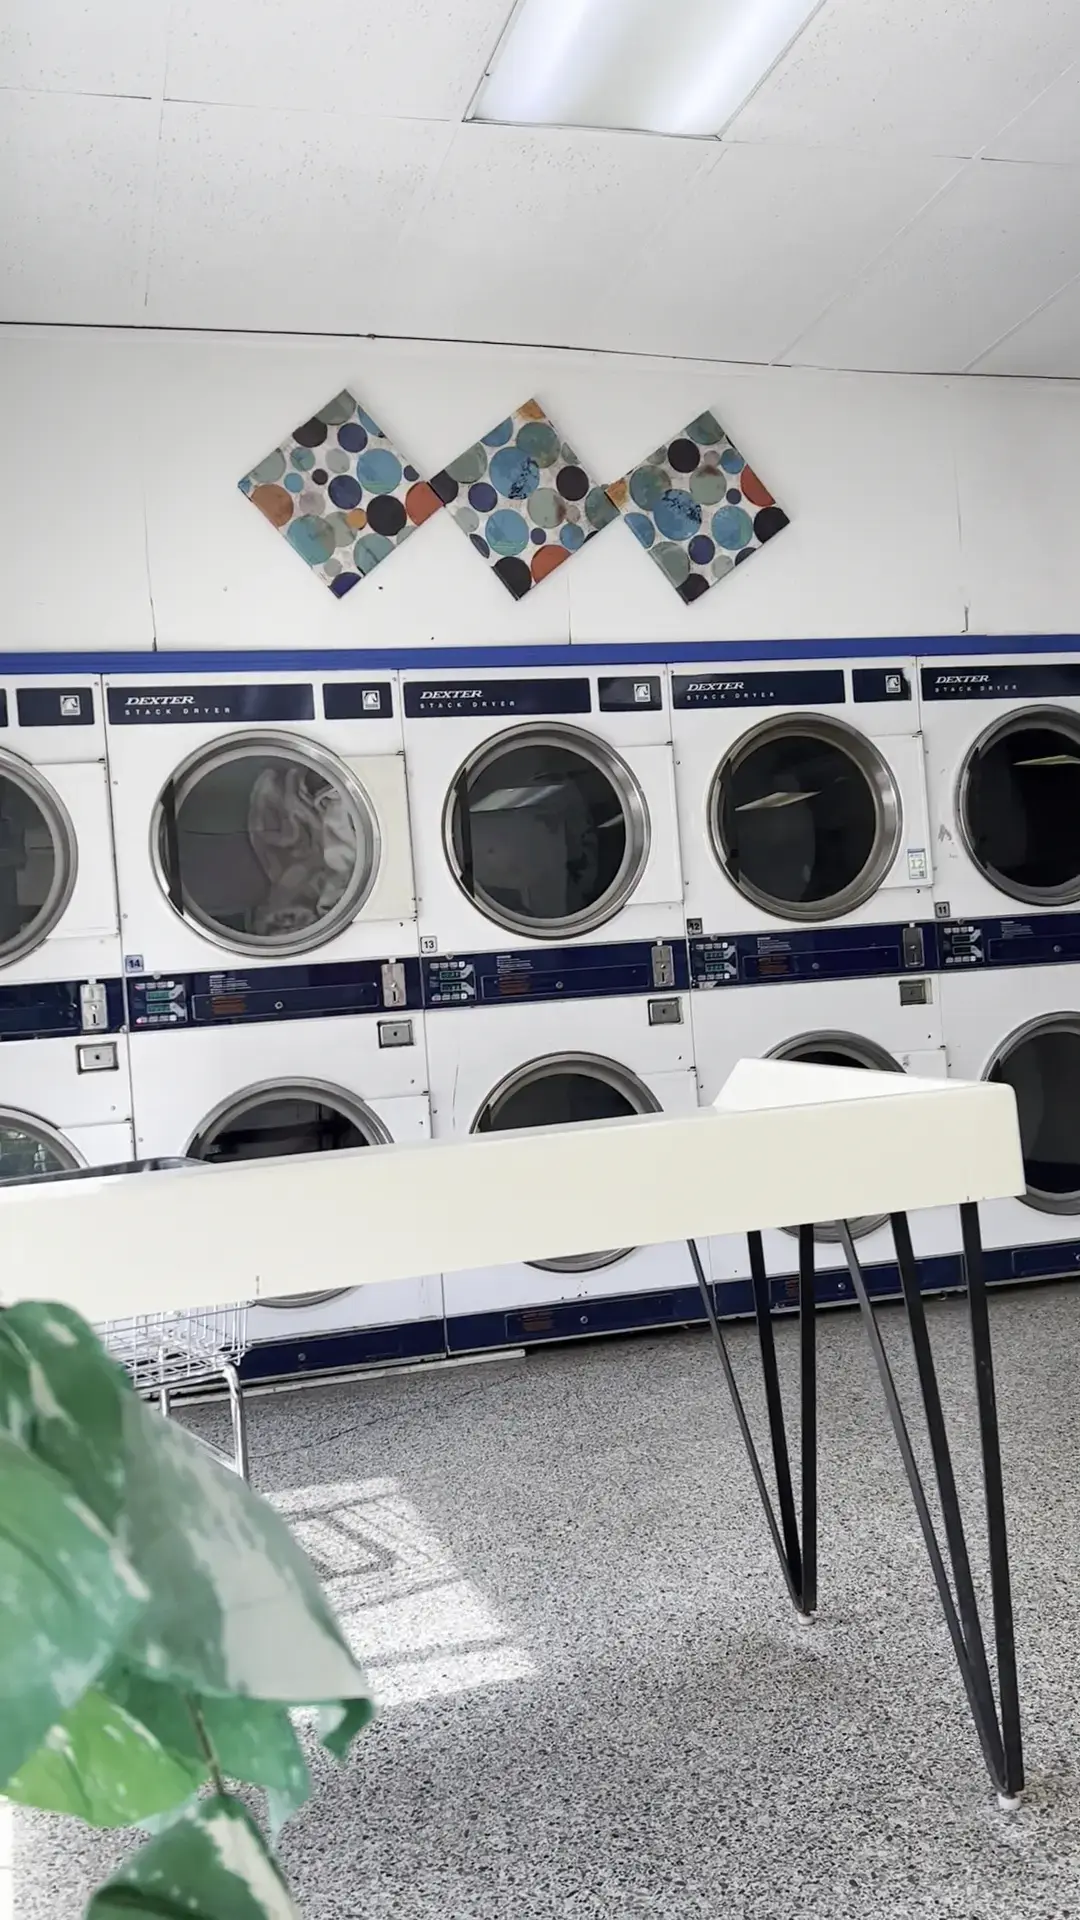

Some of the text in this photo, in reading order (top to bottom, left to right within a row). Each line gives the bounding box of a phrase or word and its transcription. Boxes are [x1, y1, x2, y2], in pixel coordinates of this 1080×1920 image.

[935, 674, 990, 684] DEXTER
[687, 681, 745, 692] DEXTER
[420, 689, 484, 700] DEXTER
[686, 691, 775, 701] STACK DRYER
[125, 695, 196, 706] DEXTER
[472, 700, 516, 708] DRYER
[125, 706, 231, 716] STACK DRYER
[911, 858, 924, 869] 12
[938, 905, 947, 914] 11
[689, 922, 701, 931] 12
[423, 940, 435, 949] 13
[129, 959, 141, 968] 14
